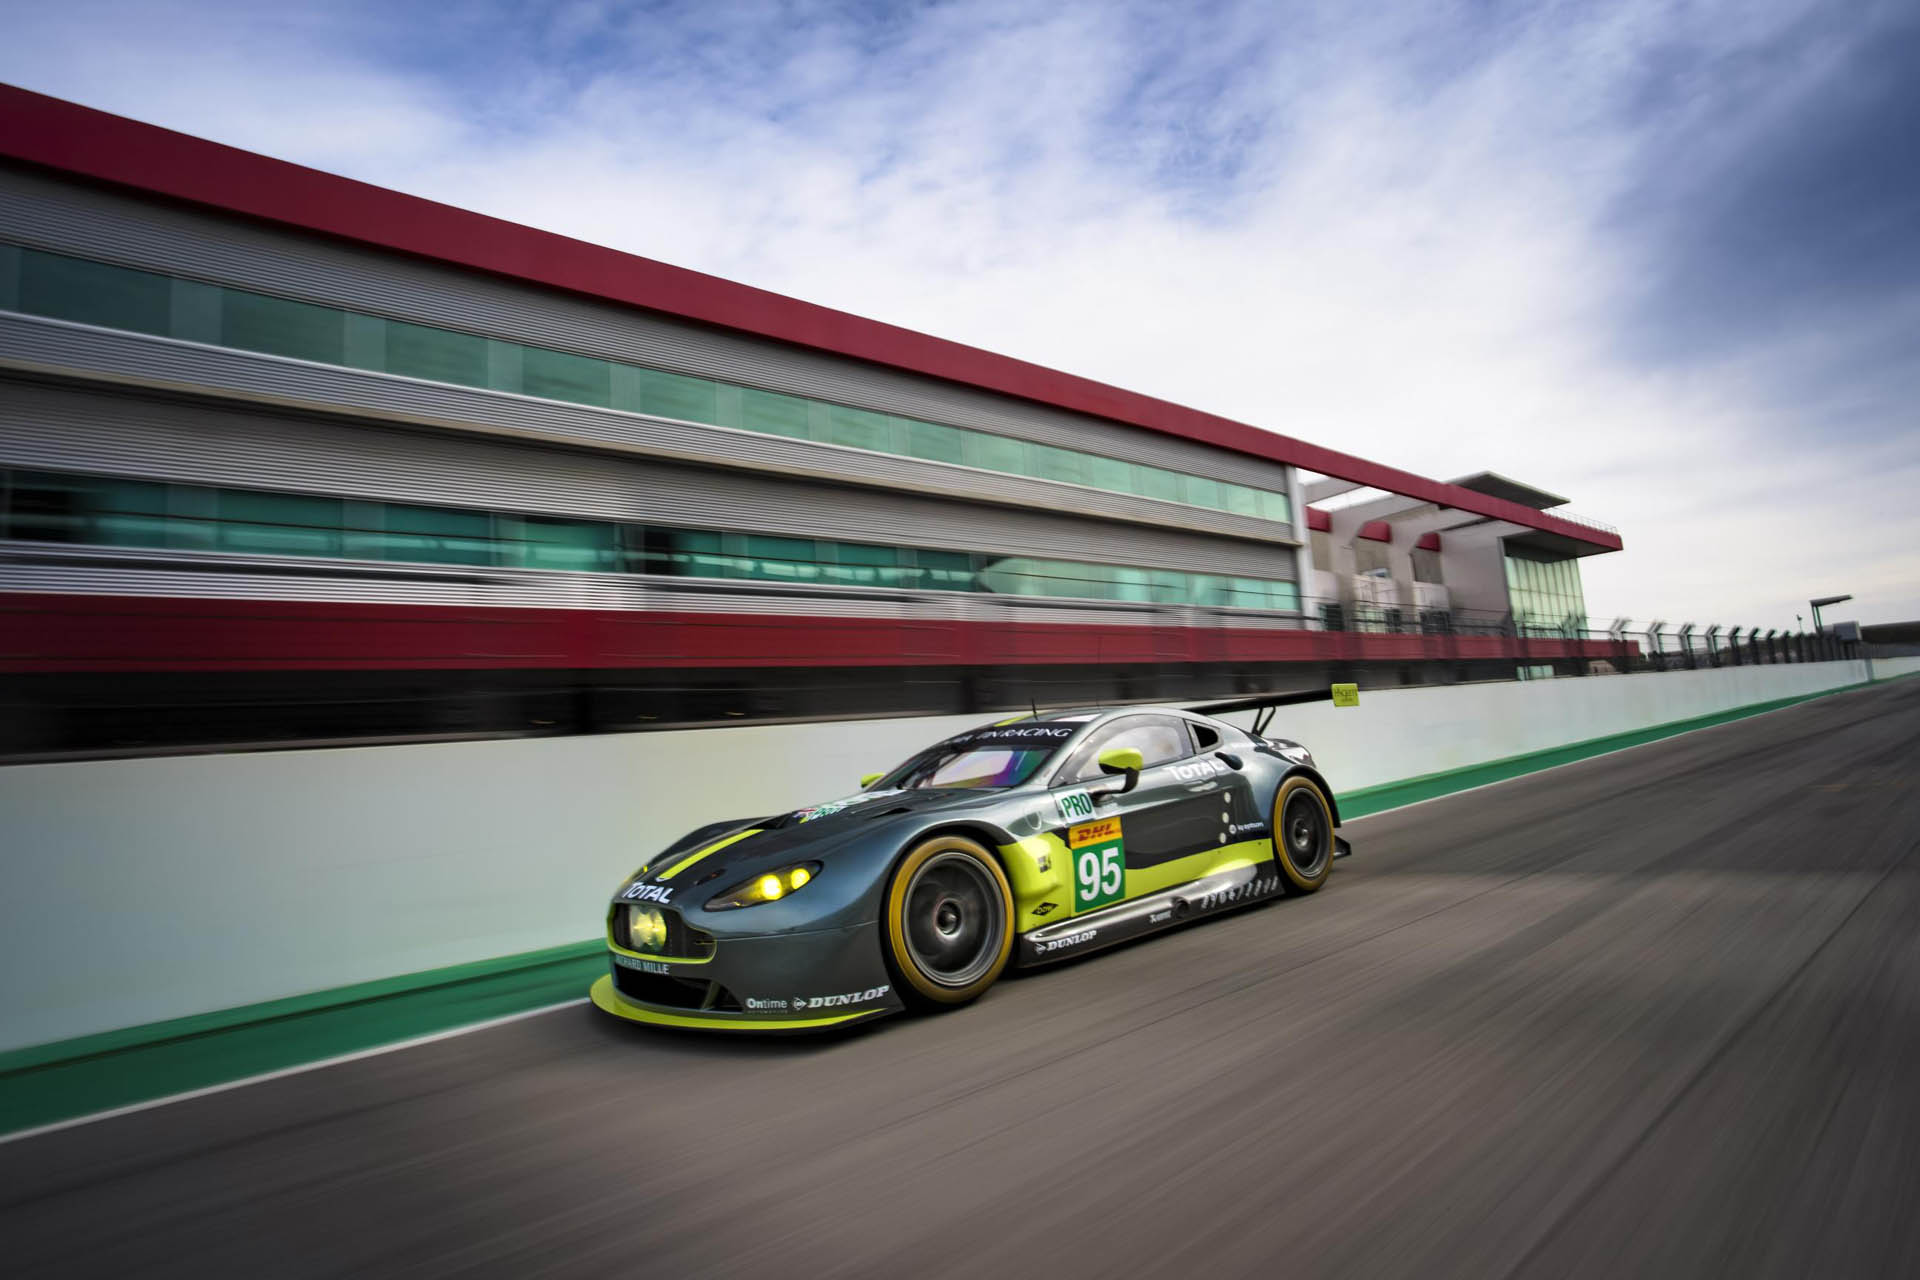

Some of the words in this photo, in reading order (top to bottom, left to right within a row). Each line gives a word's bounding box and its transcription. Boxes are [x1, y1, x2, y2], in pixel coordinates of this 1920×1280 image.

[1163, 760, 1227, 781] TOTAL
[1061, 793, 1093, 818] PRO
[1077, 823, 1114, 842] DHL
[1079, 847, 1121, 901] 95
[622, 881, 674, 904] TOTAL
[1046, 930, 1097, 951] DUNLOP
[615, 954, 641, 971] CHARD
[643, 960, 670, 975] MILLE
[745, 998, 788, 1009] Ontime
[807, 985, 890, 1009] DUNLOP
